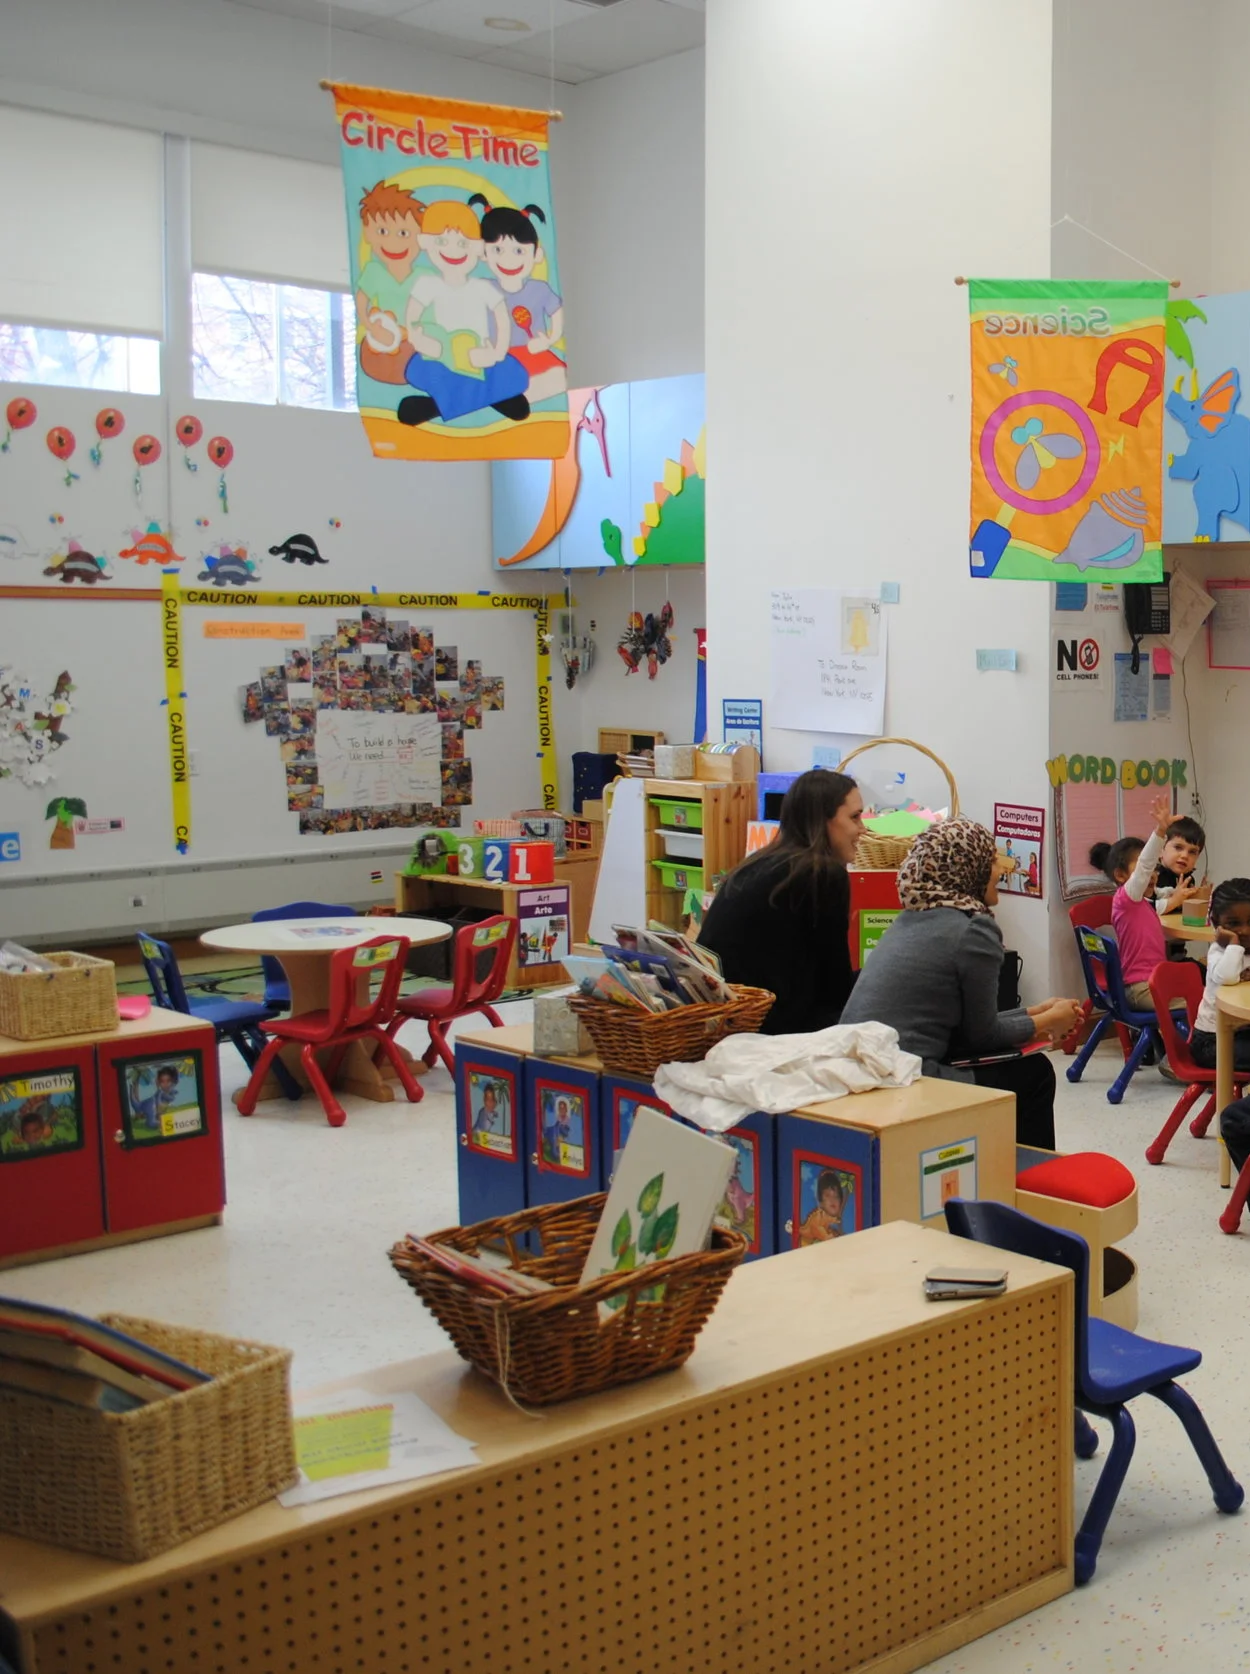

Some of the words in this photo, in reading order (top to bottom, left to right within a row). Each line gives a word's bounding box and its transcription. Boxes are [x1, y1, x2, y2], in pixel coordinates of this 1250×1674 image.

[340, 111, 450, 162] Circle
[452, 123, 540, 170] Time
[187, 591, 258, 604] CAUTION
[298, 594, 361, 605] CAUTION
[399, 594, 458, 606] CAUTION
[165, 598, 179, 668] CAUTION
[538, 686, 551, 747] CAUTION
[170, 712, 186, 782] CAUTION
[1045, 753, 1117, 787] WORD
[1120, 758, 1188, 790] BOOK
[1000, 809, 1039, 823] Computers
[997, 825, 1041, 838] Computadoras
[458, 844, 475, 875] 3
[485, 845, 504, 878] 2
[514, 848, 532, 881] 1
[536, 894, 551, 903] Art
[534, 906, 553, 915] Arte
[867, 917, 893, 925] Science
[22, 1074, 74, 1092] Timothy
[165, 1117, 201, 1131] Stacey
